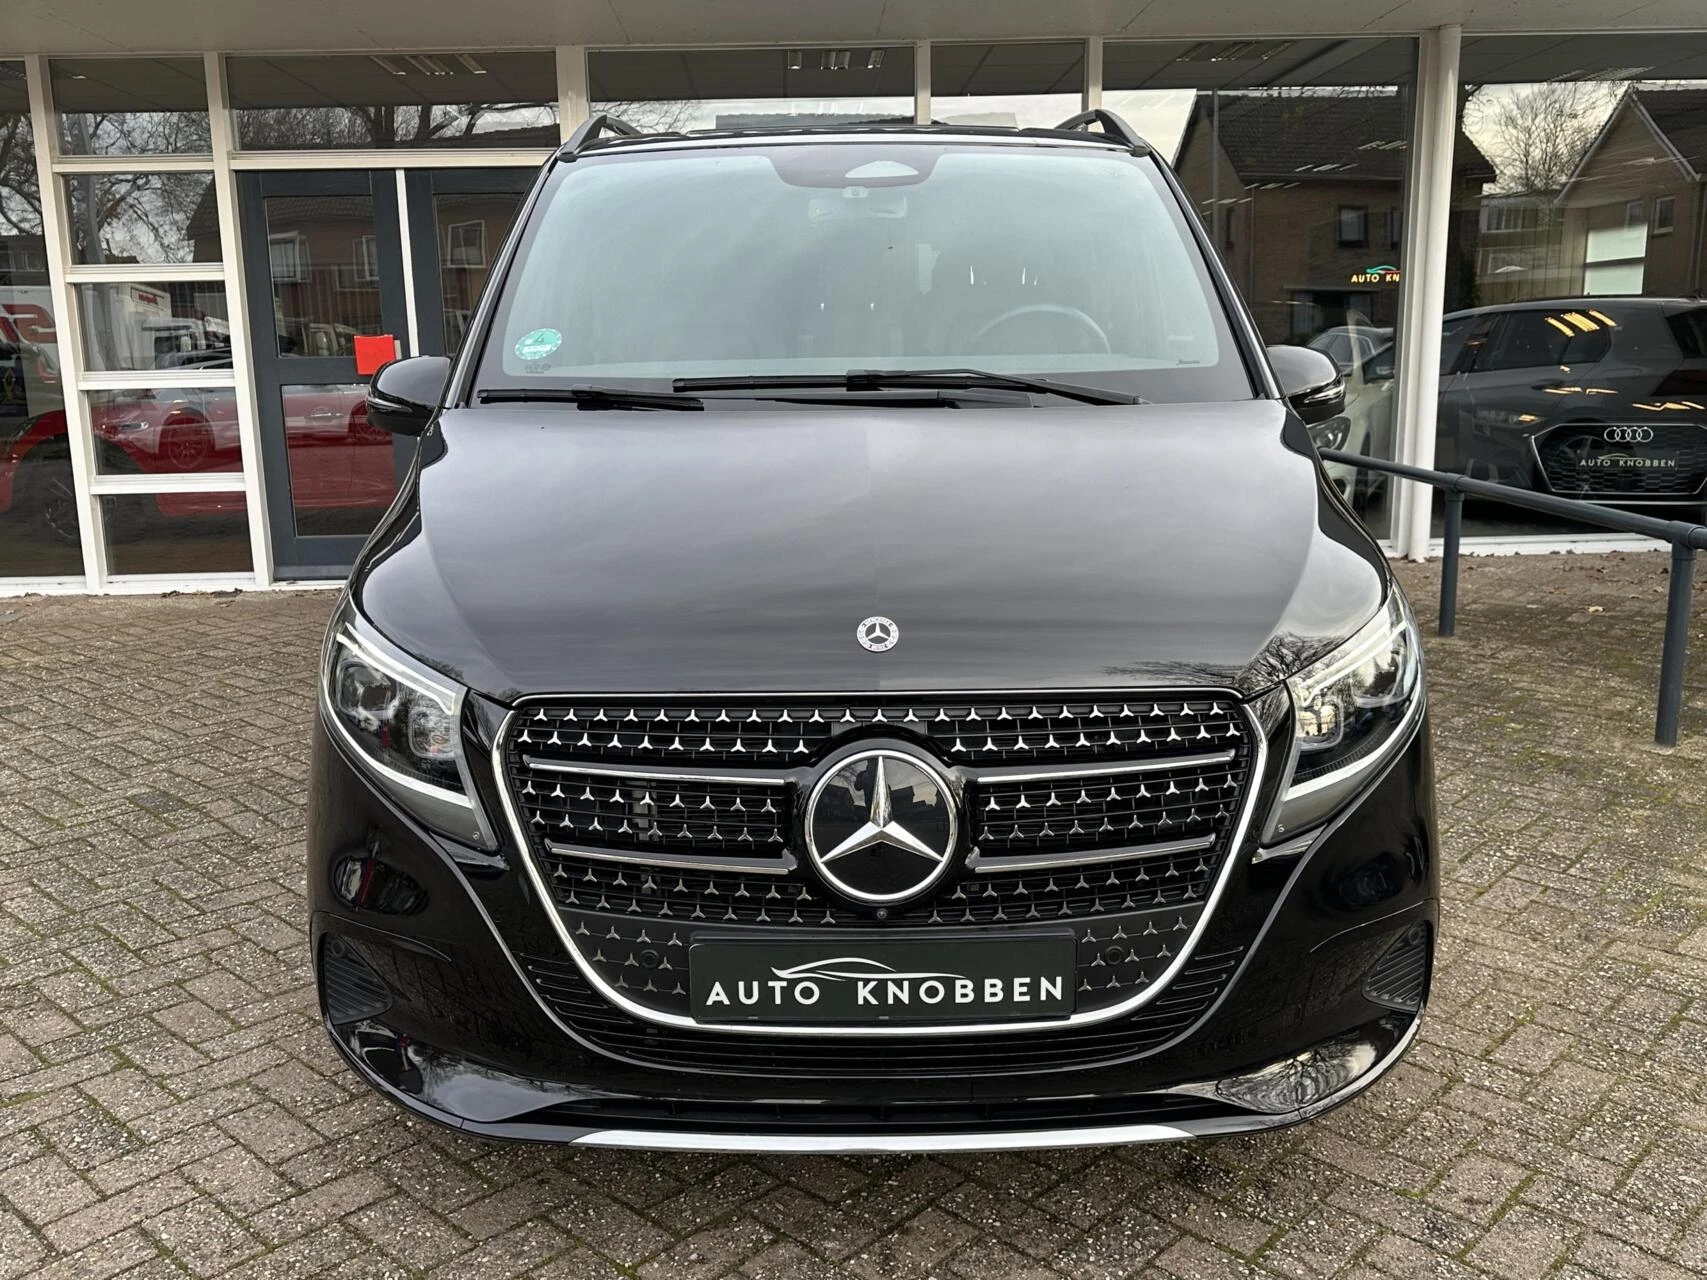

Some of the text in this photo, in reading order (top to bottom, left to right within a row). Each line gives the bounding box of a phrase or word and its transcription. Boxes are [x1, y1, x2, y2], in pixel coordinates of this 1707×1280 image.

[1351, 274, 1380, 283] AUTO
[1580, 459, 1676, 467] AUTO KNOBBEN
[705, 976, 1062, 1006] AUTO KNOBBEN
